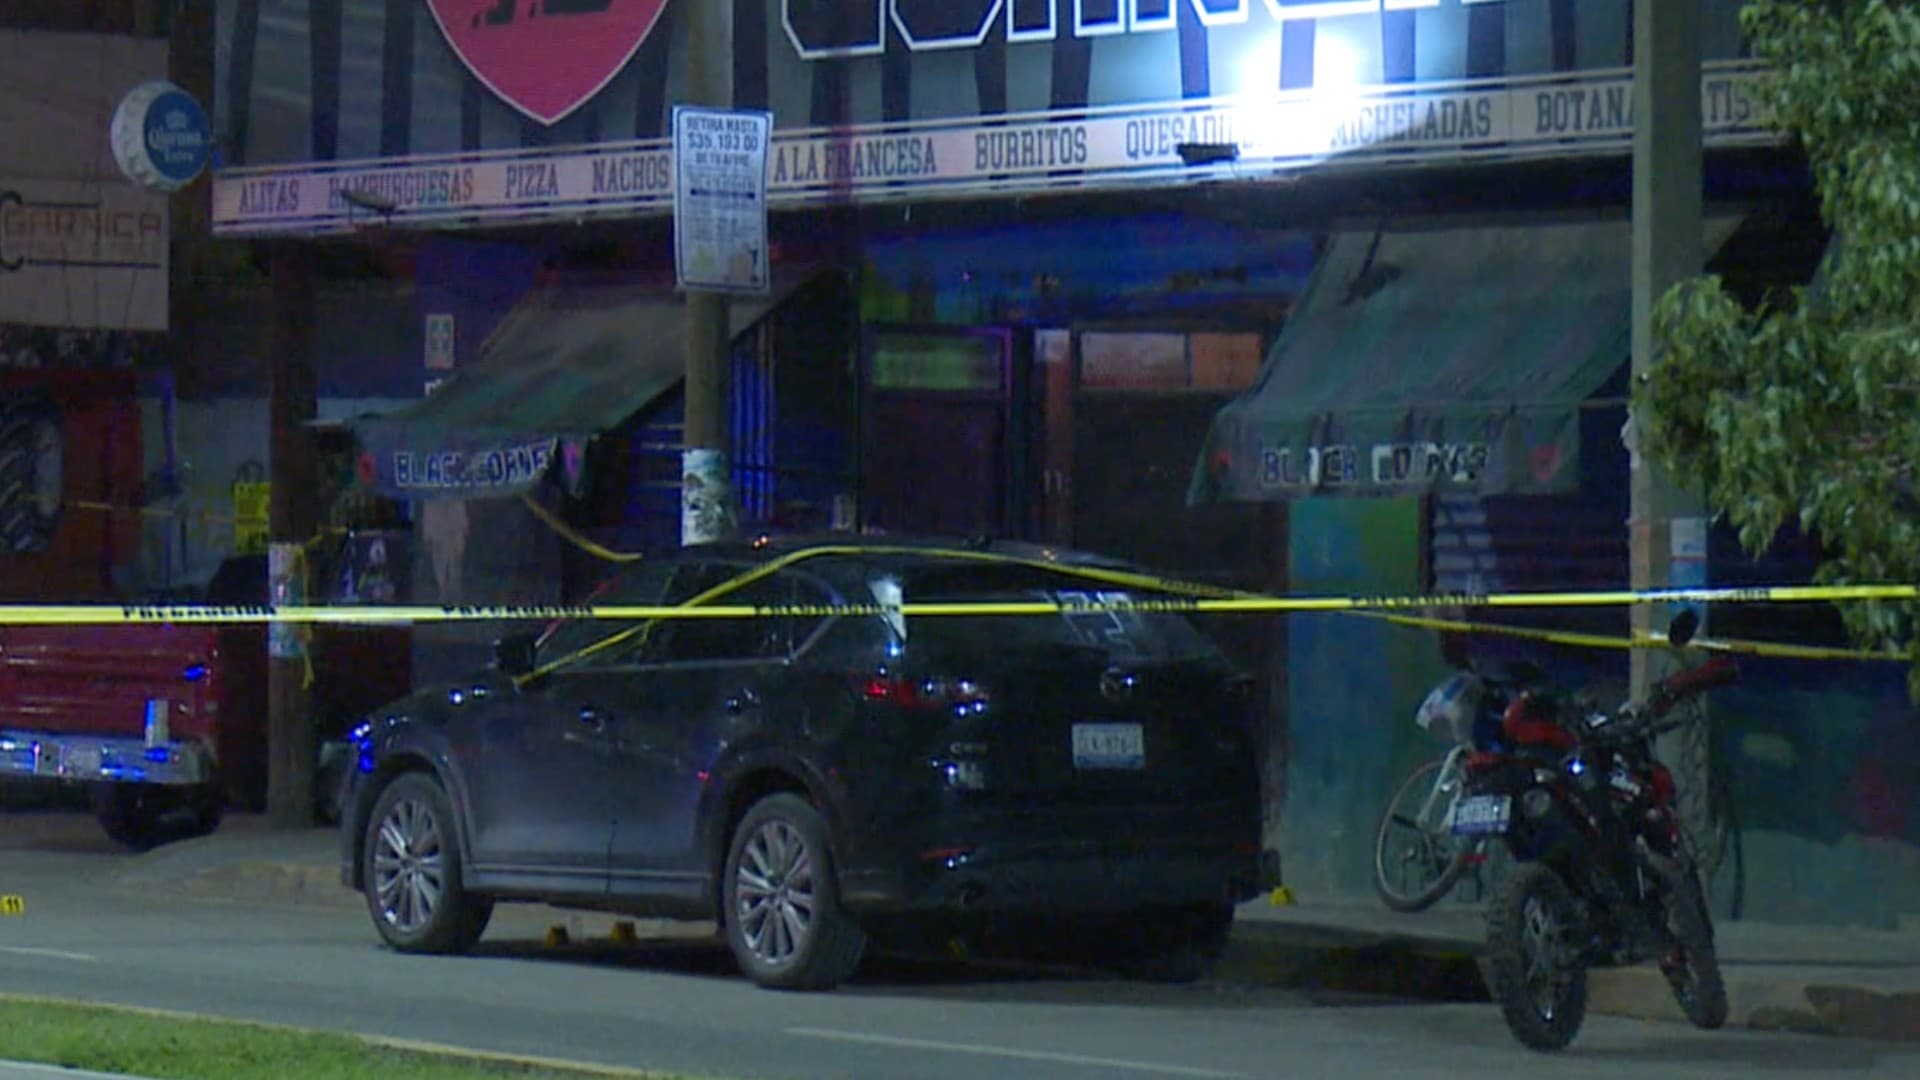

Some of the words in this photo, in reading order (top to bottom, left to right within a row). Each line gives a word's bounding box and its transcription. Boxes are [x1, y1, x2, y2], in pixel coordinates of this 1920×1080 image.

[975, 126, 1087, 170] BURRITOS
[505, 163, 559, 199] PIZZA
[592, 155, 670, 192] NACHOS
[239, 179, 300, 214] ALITAS
